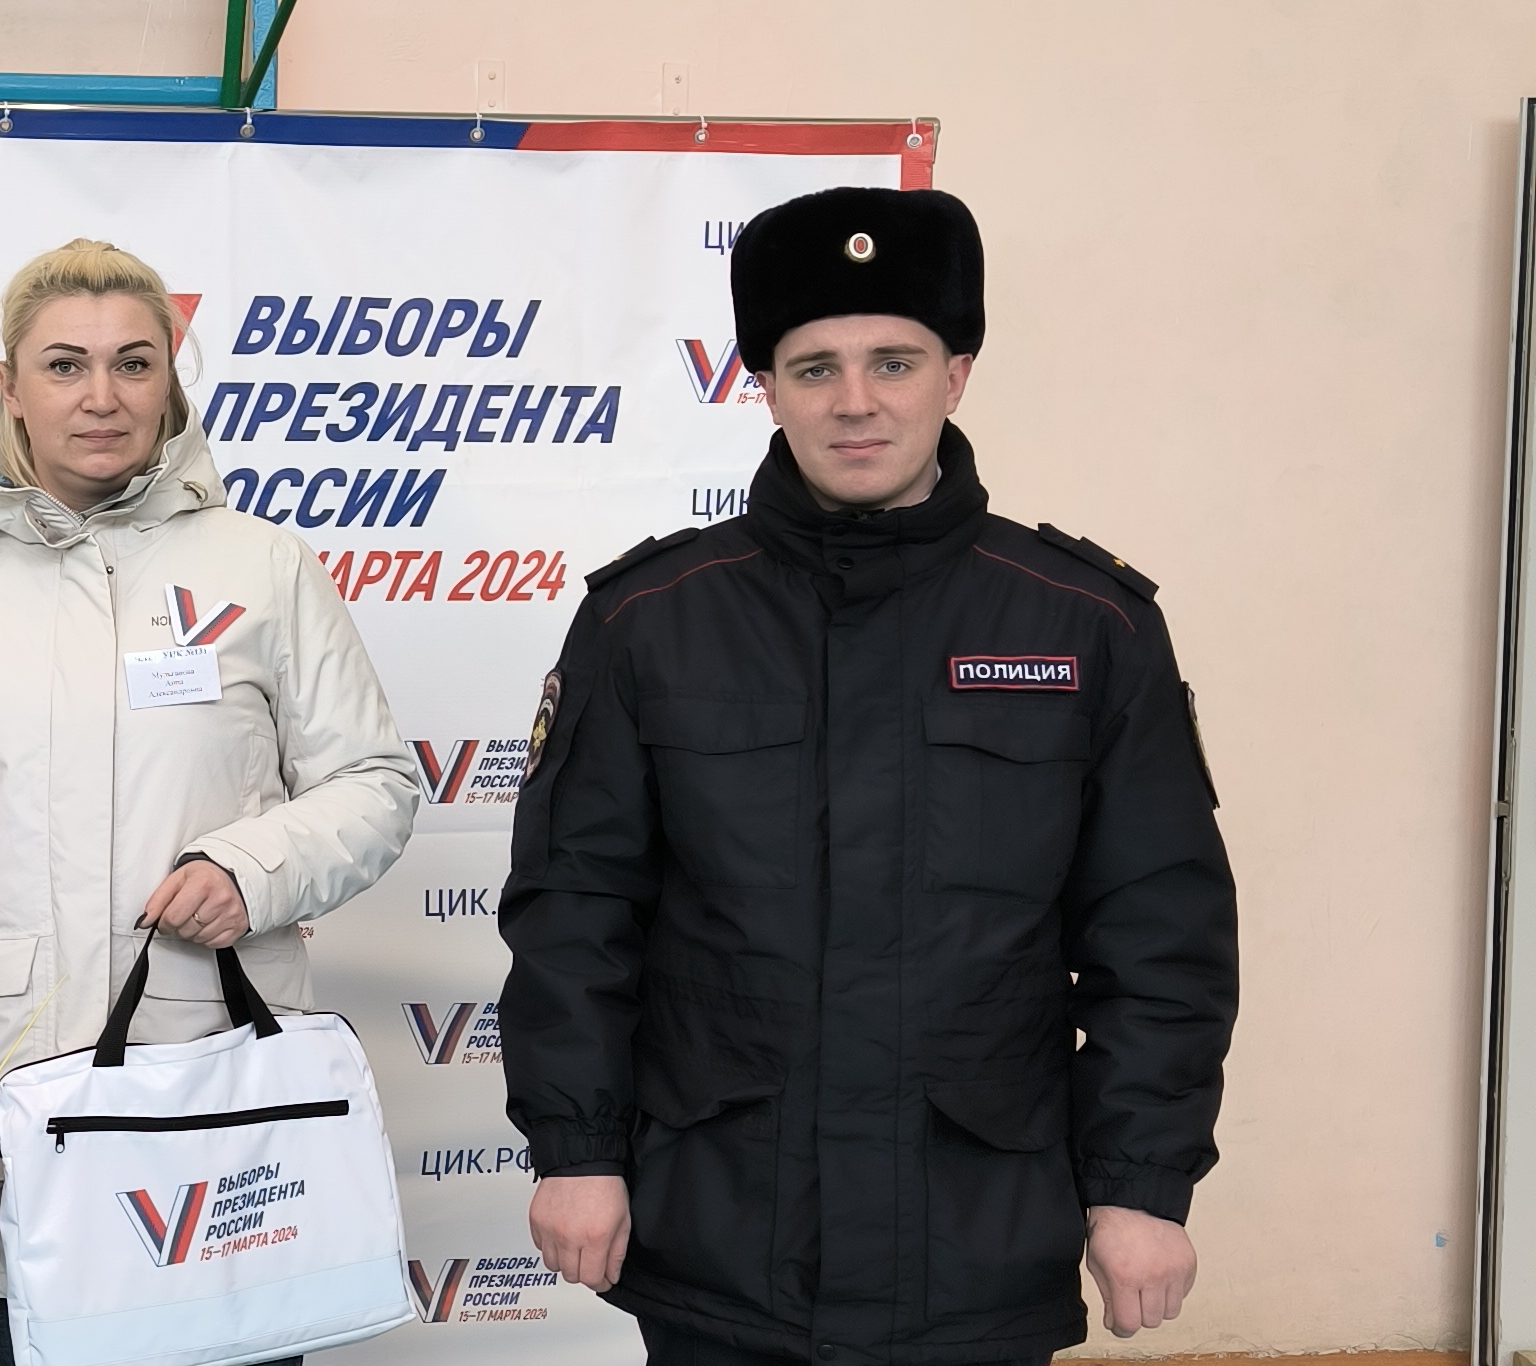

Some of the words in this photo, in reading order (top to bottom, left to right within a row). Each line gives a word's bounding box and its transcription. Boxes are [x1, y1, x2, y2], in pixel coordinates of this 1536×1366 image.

[231, 295, 542, 358] ВЫБОРЫ
[203, 381, 621, 451] ПРЕЗИДЕНТА
[222, 467, 447, 528] ОССИИ
[321, 550, 443, 602] АРТА
[447, 549, 566, 602] 2024
[958, 663, 1071, 682] ПОЛИЦИЯ
[485, 739, 530, 754] ВЫБО
[217, 1162, 281, 1194] ВЫБОРЫ
[211, 1180, 305, 1218] ПРЕЗИДЕНТА
[205, 1211, 264, 1242] РОССИИ
[231, 1232, 268, 1255] МАРТА
[270, 1225, 299, 1244] 2024
[475, 1256, 540, 1271] ВЫБОРЫ
[468, 1273, 558, 1289] ПРЕЗИДЕНТА
[463, 1291, 521, 1306] РОССИИ
[487, 1308, 522, 1321] МАРТА
[523, 1308, 548, 1320] 2024
